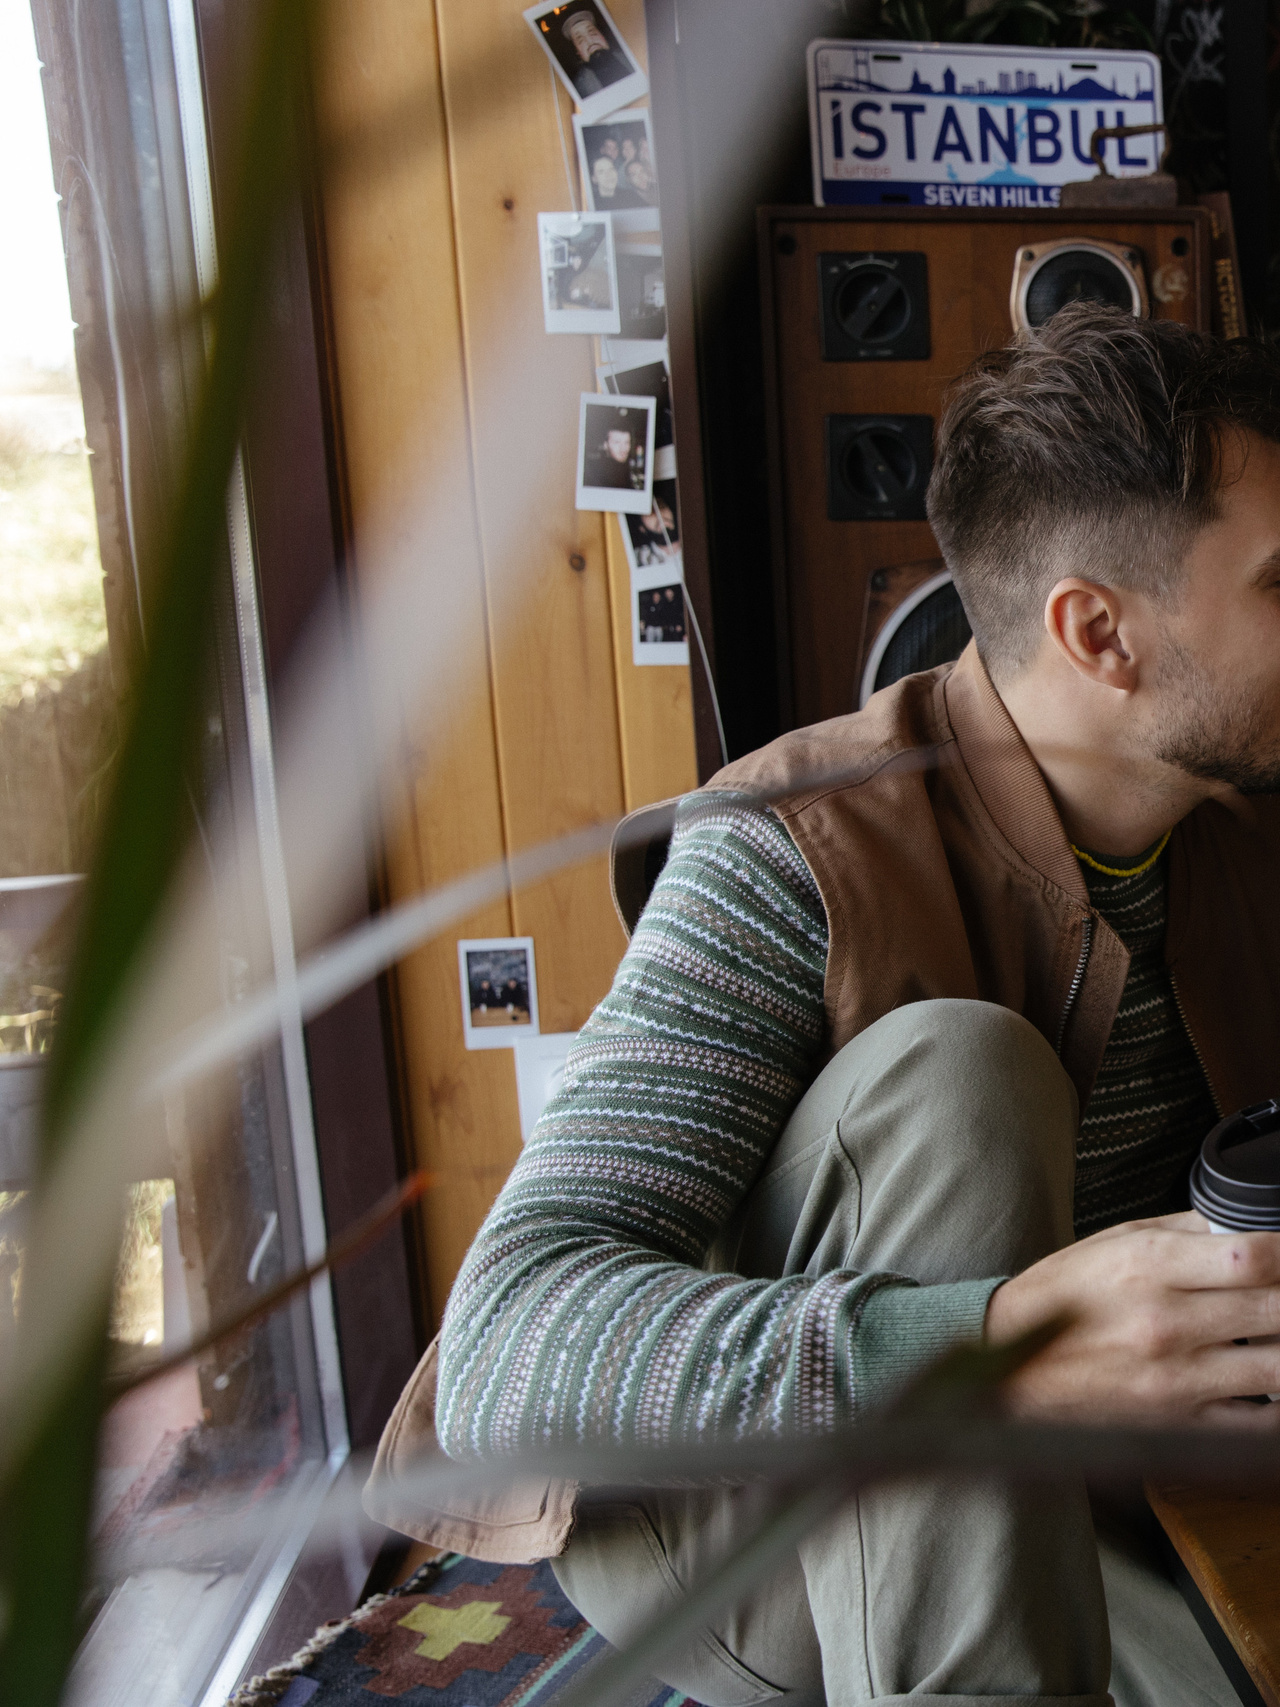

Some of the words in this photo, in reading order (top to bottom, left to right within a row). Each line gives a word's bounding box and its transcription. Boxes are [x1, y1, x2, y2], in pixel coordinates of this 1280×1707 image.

[833, 161, 892, 177] Europe
[923, 184, 996, 207] SEVEN
[1000, 186, 1061, 208] HILLS
